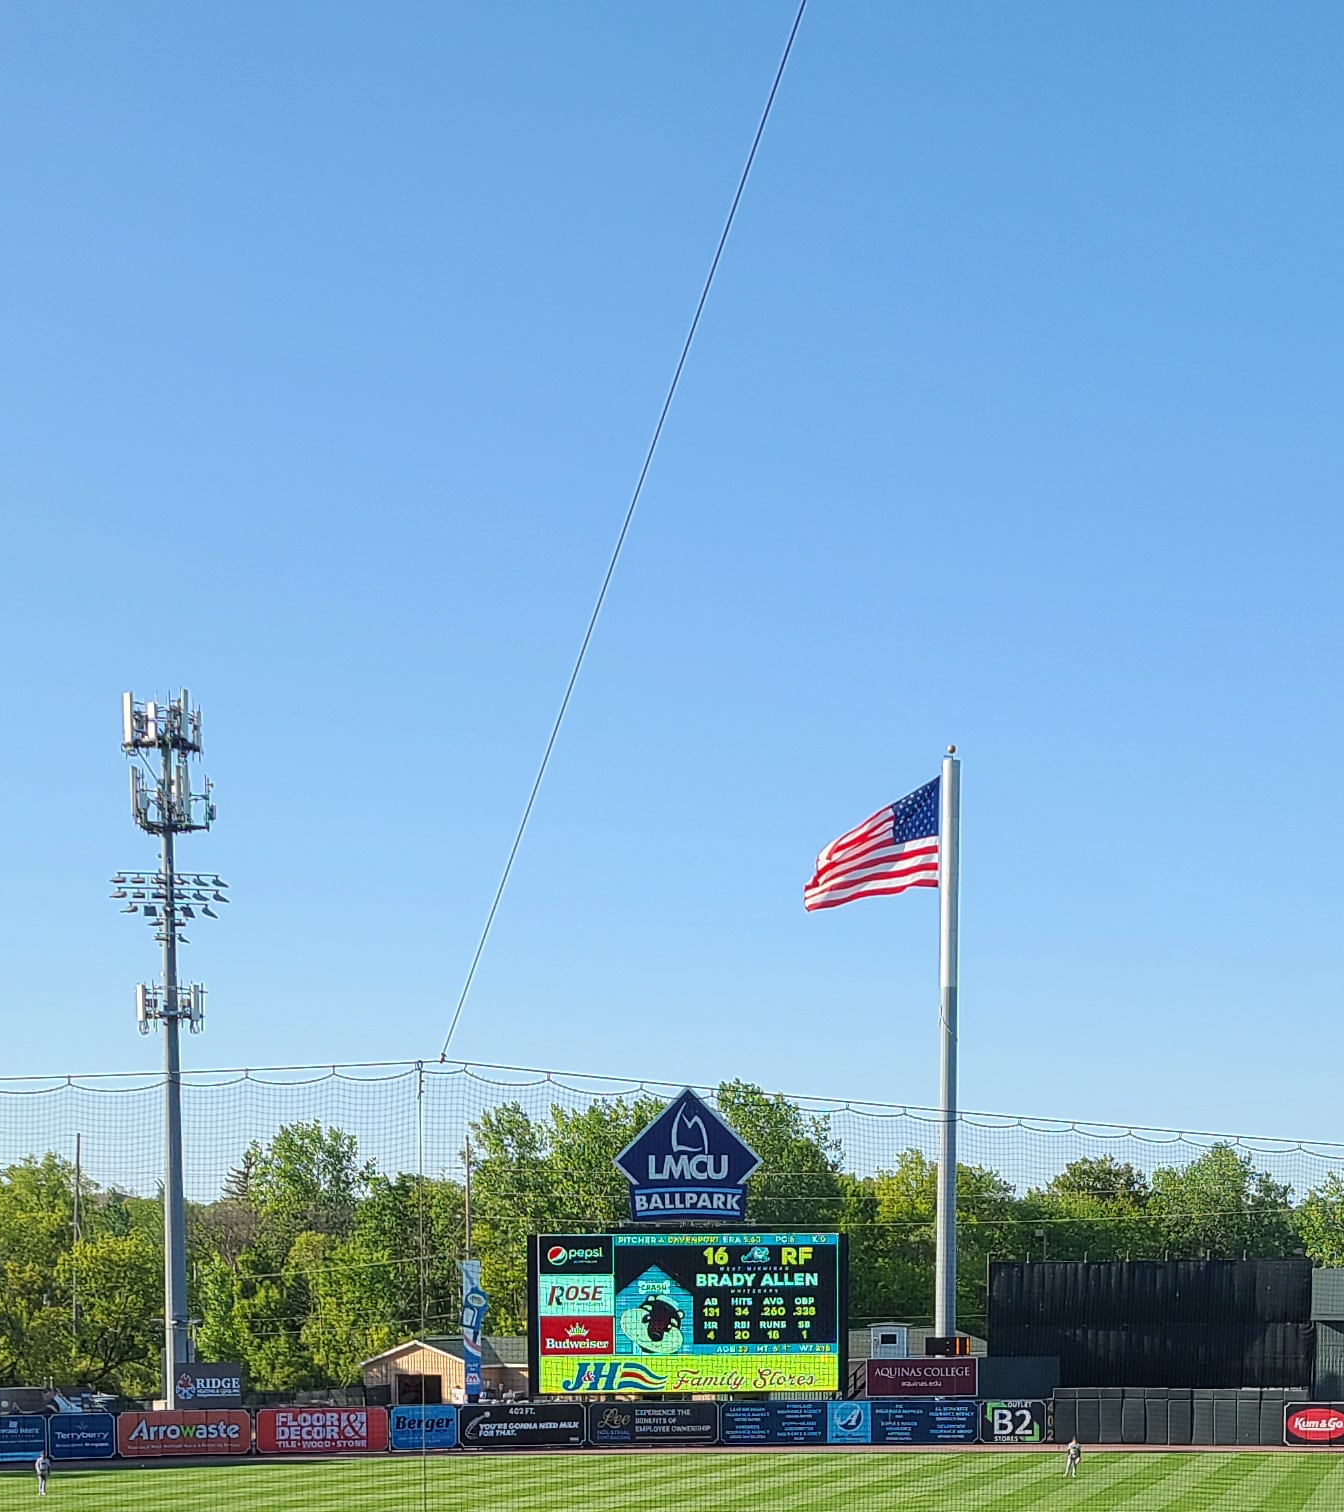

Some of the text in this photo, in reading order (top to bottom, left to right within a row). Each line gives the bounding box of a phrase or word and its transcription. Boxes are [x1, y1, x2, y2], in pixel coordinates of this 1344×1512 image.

[648, 1154, 730, 1181] LMCU
[635, 1193, 741, 1212] BALLPARK
[618, 1236, 657, 1245] PITCHER
[569, 1247, 603, 1260] pepsi
[703, 1247, 813, 1265] 16 RF
[696, 1272, 818, 1287] BRADY ALLEN
[548, 1286, 604, 1306] ROSE
[731, 1298, 753, 1306] HITS
[763, 1297, 784, 1305] AVG
[795, 1297, 815, 1305] OBP
[703, 1307, 749, 1317] 131 34
[734, 1321, 787, 1329] RBI RUNS
[706, 1331, 808, 1340] 4 20 1
[545, 1338, 609, 1349] Budweiser
[673, 1369, 745, 1390] Family
[753, 1368, 816, 1388] Stores
[874, 1366, 971, 1379] AQUINAS COLLEGE
[196, 1378, 241, 1389] RIDGE
[276, 1413, 339, 1427] FLOOR
[597, 1407, 631, 1428] Lee
[993, 1409, 1033, 1436] B2
[128, 1418, 240, 1442] Arrowaste
[395, 1416, 454, 1433] Berger
[55, 1431, 109, 1440] Terryberry
[276, 1427, 339, 1440] DECOR
[336, 1440, 367, 1448] STONE
